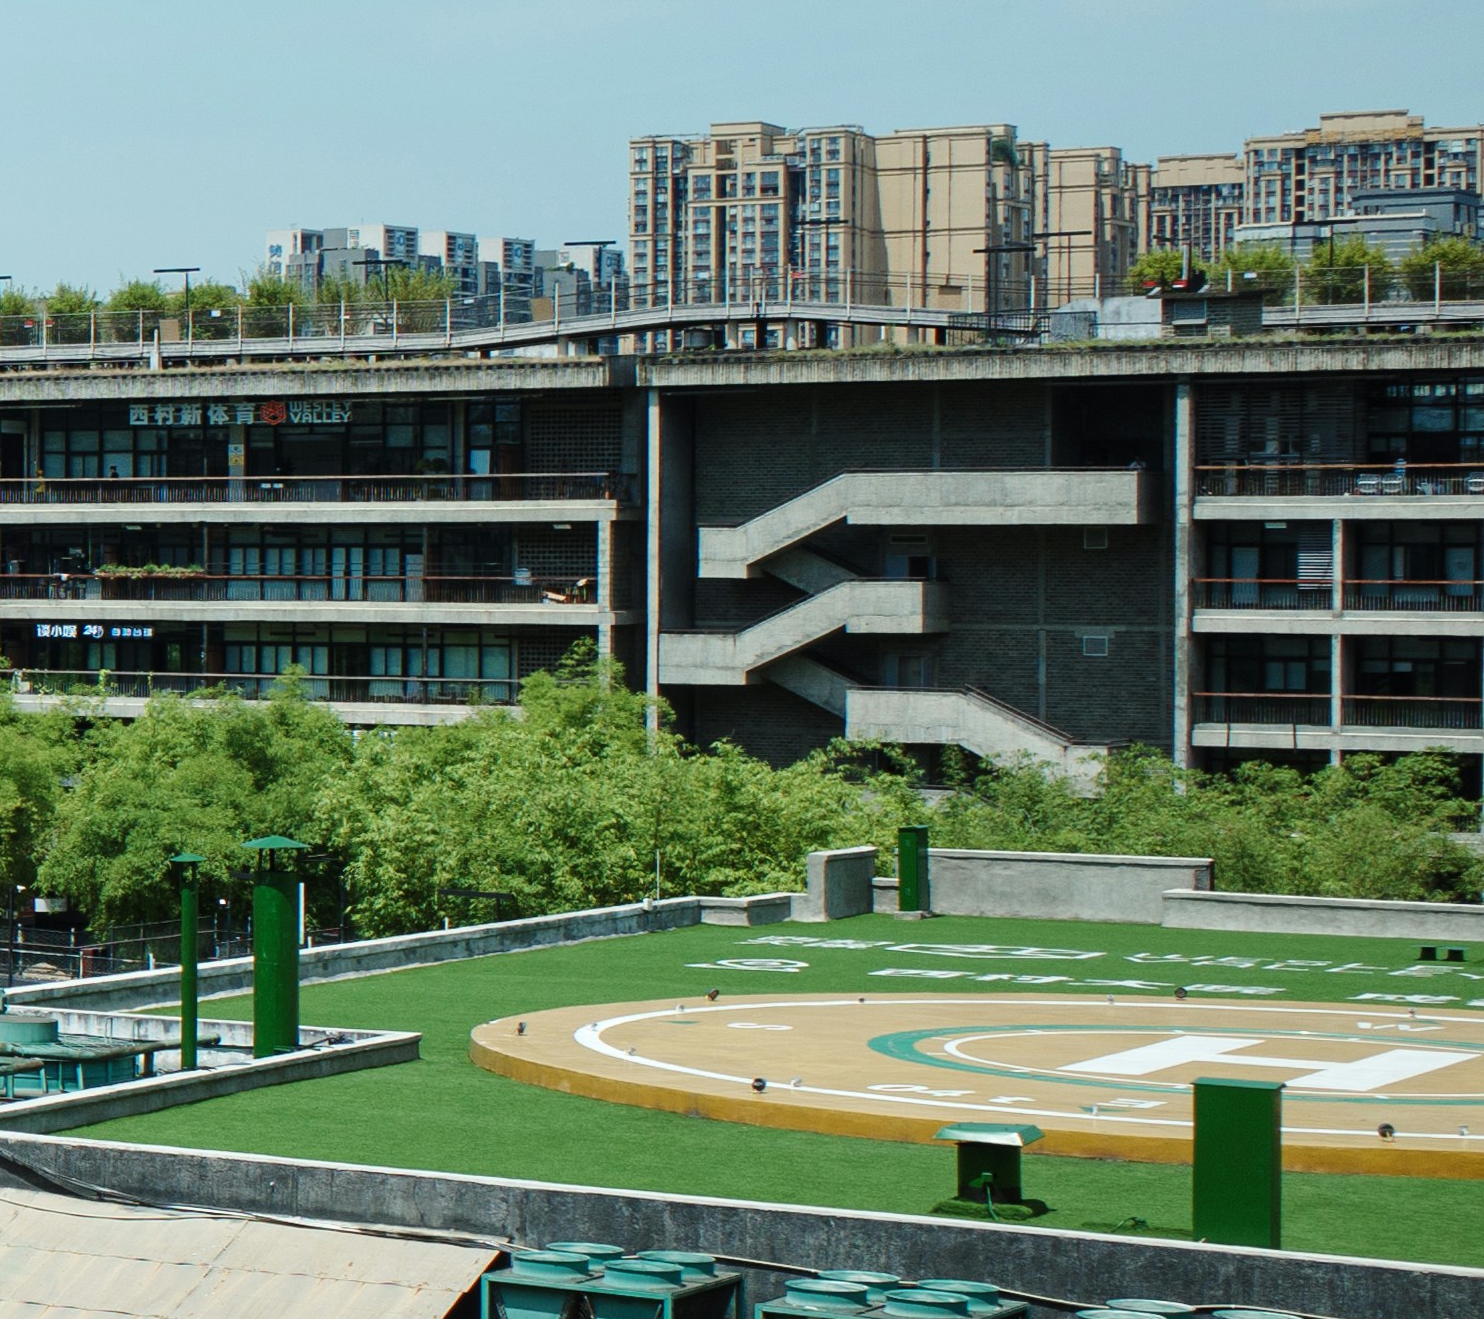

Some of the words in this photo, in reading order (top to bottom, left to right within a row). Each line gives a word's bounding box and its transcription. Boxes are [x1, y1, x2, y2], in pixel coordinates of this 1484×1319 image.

[129, 402, 255, 425] 西村新体育
[289, 400, 351, 412] WESLEY
[290, 411, 350, 424] VALLEY
[1057, 1035, 1484, 1093] H
